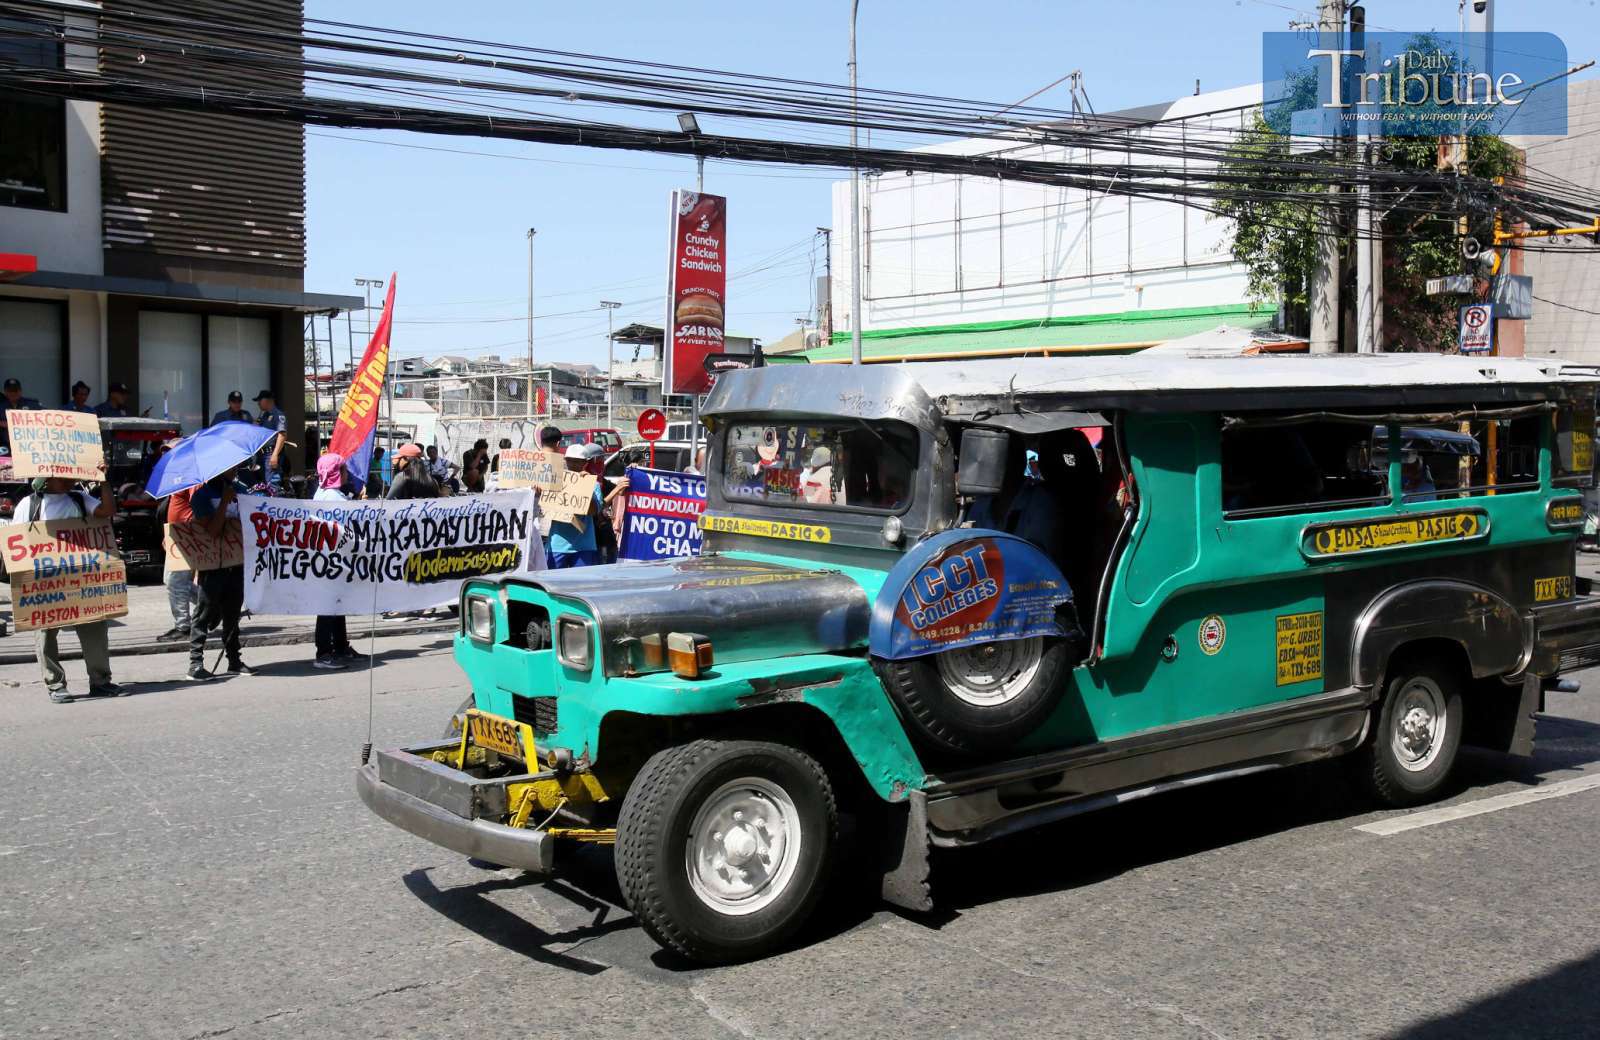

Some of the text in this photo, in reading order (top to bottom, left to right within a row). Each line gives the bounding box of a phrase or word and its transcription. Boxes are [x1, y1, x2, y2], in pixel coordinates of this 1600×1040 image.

[685, 233, 719, 249] Crunchy
[685, 246, 718, 260] Chicken
[681, 258, 722, 272] Sandwich
[11, 412, 76, 427] MARCOS
[19, 440, 84, 454] NG TAONG
[500, 449, 545, 461] MARCOS
[32, 452, 77, 465] BAYAN
[500, 460, 553, 473] PAHIRAP SA
[38, 465, 73, 474] PISTON
[562, 471, 579, 484] TO
[647, 473, 683, 495] YES
[684, 479, 707, 498] TO
[394, 502, 416, 520] at
[628, 494, 702, 515] INDIVIDUAL
[249, 511, 339, 552] BIGUIN
[350, 508, 529, 553] MAKADAYUHAN
[630, 514, 659, 535] NO
[661, 518, 687, 536] TO
[713, 519, 739, 532] EDSA
[770, 524, 812, 540] PASIG
[1335, 526, 1375, 547] EDSA
[1416, 515, 1457, 538] PASIG
[7, 534, 27, 561] 5
[267, 547, 403, 583] NEGOSYONG
[22, 578, 66, 594] LABAN
[82, 570, 123, 584] TSUPER
[902, 544, 988, 614] ICCT
[1536, 577, 1570, 600] TXX 689
[20, 591, 67, 607] KASAMA
[911, 577, 998, 630] COLLEGES
[31, 603, 116, 626] PISTON WOMEN
[1298, 629, 1320, 645] URBIS
[1279, 647, 1296, 663] EDSA
